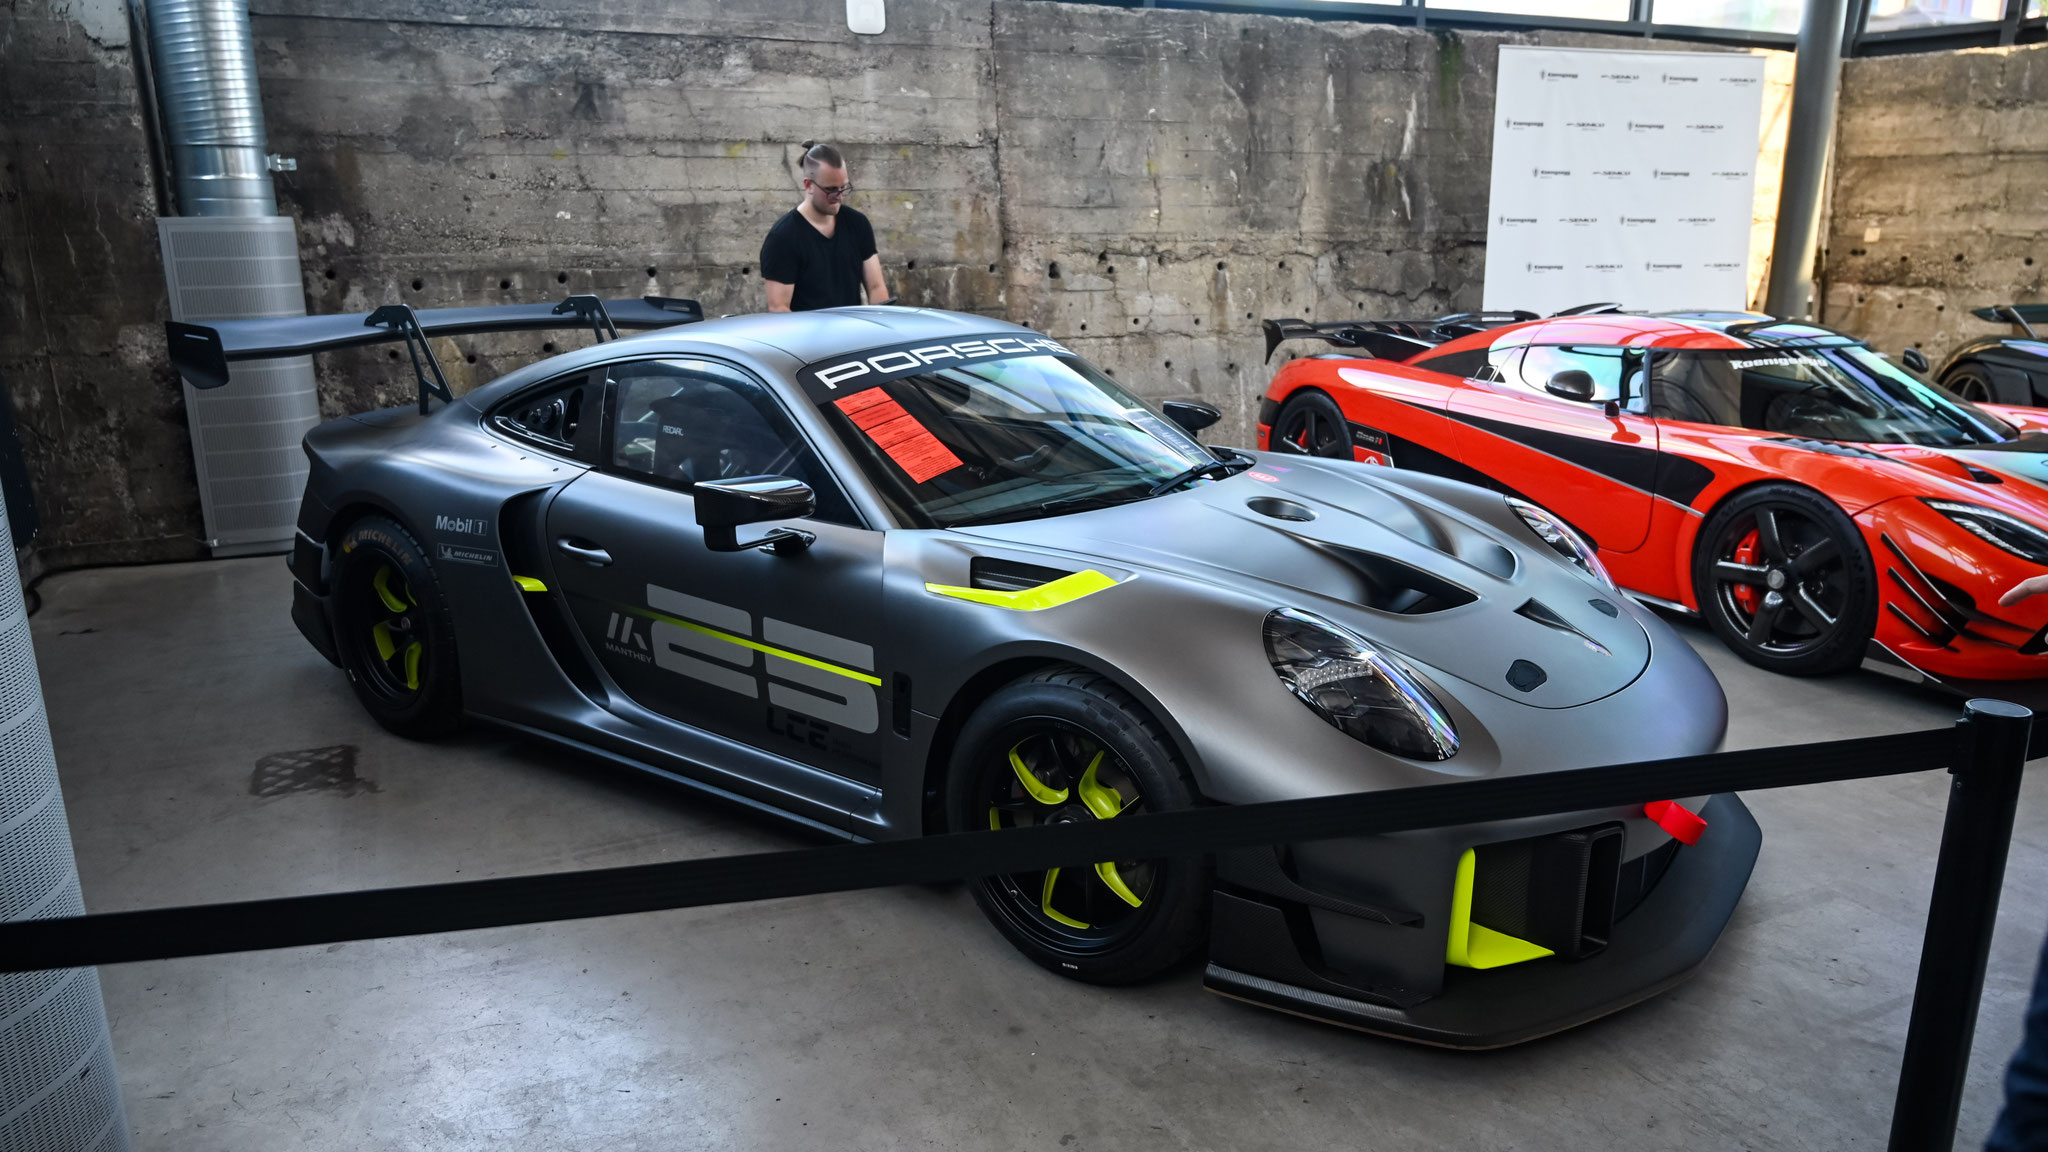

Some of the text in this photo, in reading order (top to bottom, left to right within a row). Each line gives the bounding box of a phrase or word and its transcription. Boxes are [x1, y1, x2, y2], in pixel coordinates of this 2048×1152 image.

[815, 338, 1078, 389] PORSCHE
[435, 514, 485, 534] Mobil 1
[358, 528, 414, 566] MICHELIN
[453, 550, 493, 562] MICHELIN
[605, 641, 653, 664] MANTHEY
[646, 583, 879, 734] 25
